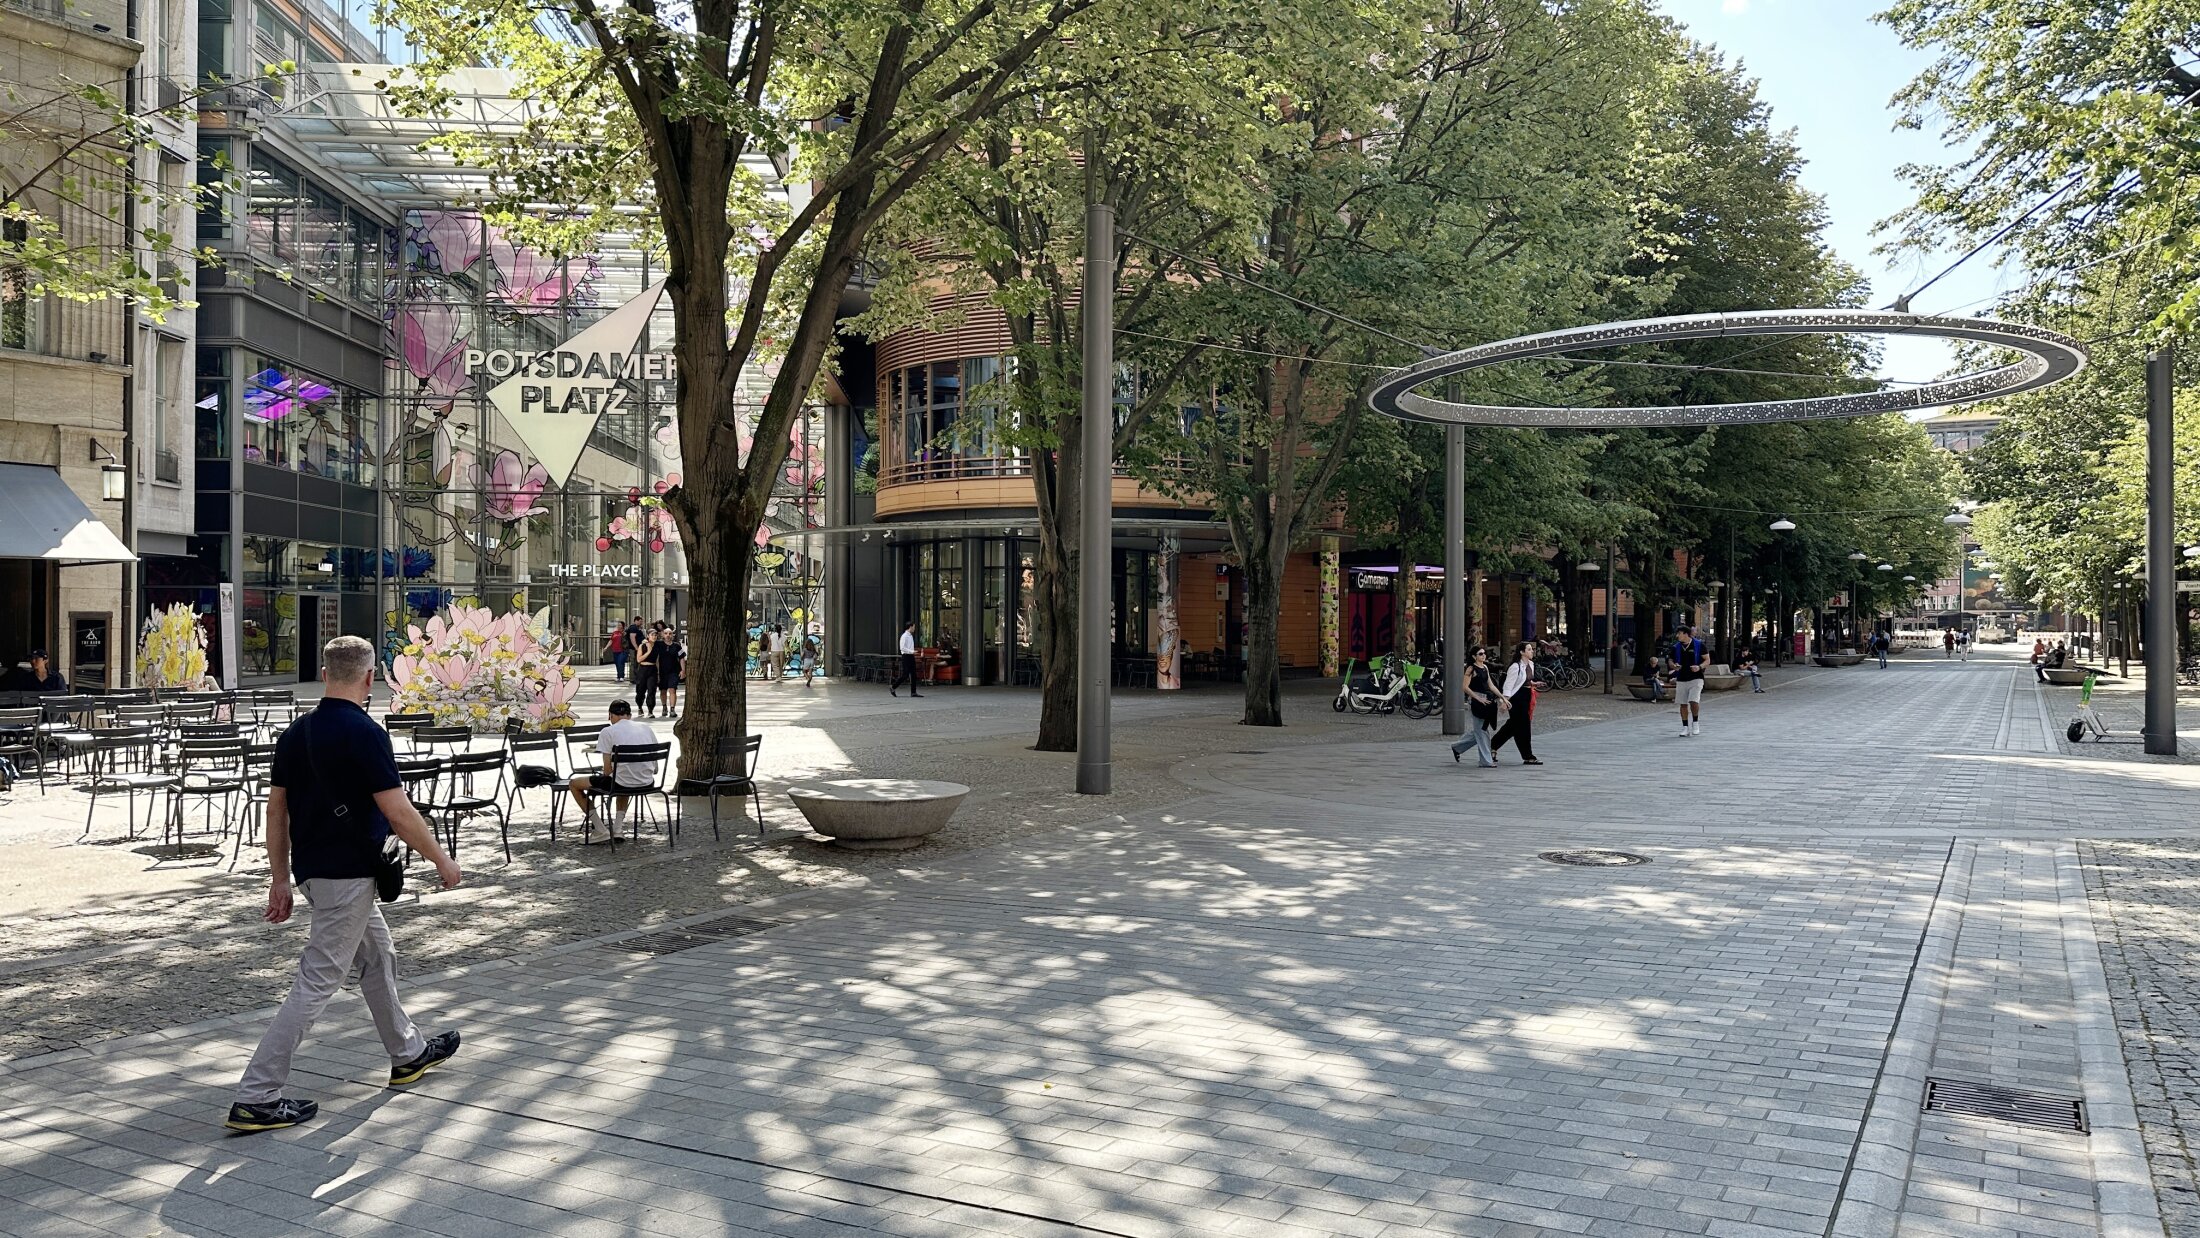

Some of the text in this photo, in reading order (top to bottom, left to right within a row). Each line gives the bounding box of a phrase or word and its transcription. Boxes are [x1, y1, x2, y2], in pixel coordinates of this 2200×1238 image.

[521, 385, 628, 415] PLATZ
[549, 564, 639, 577] THE PLAYCE
